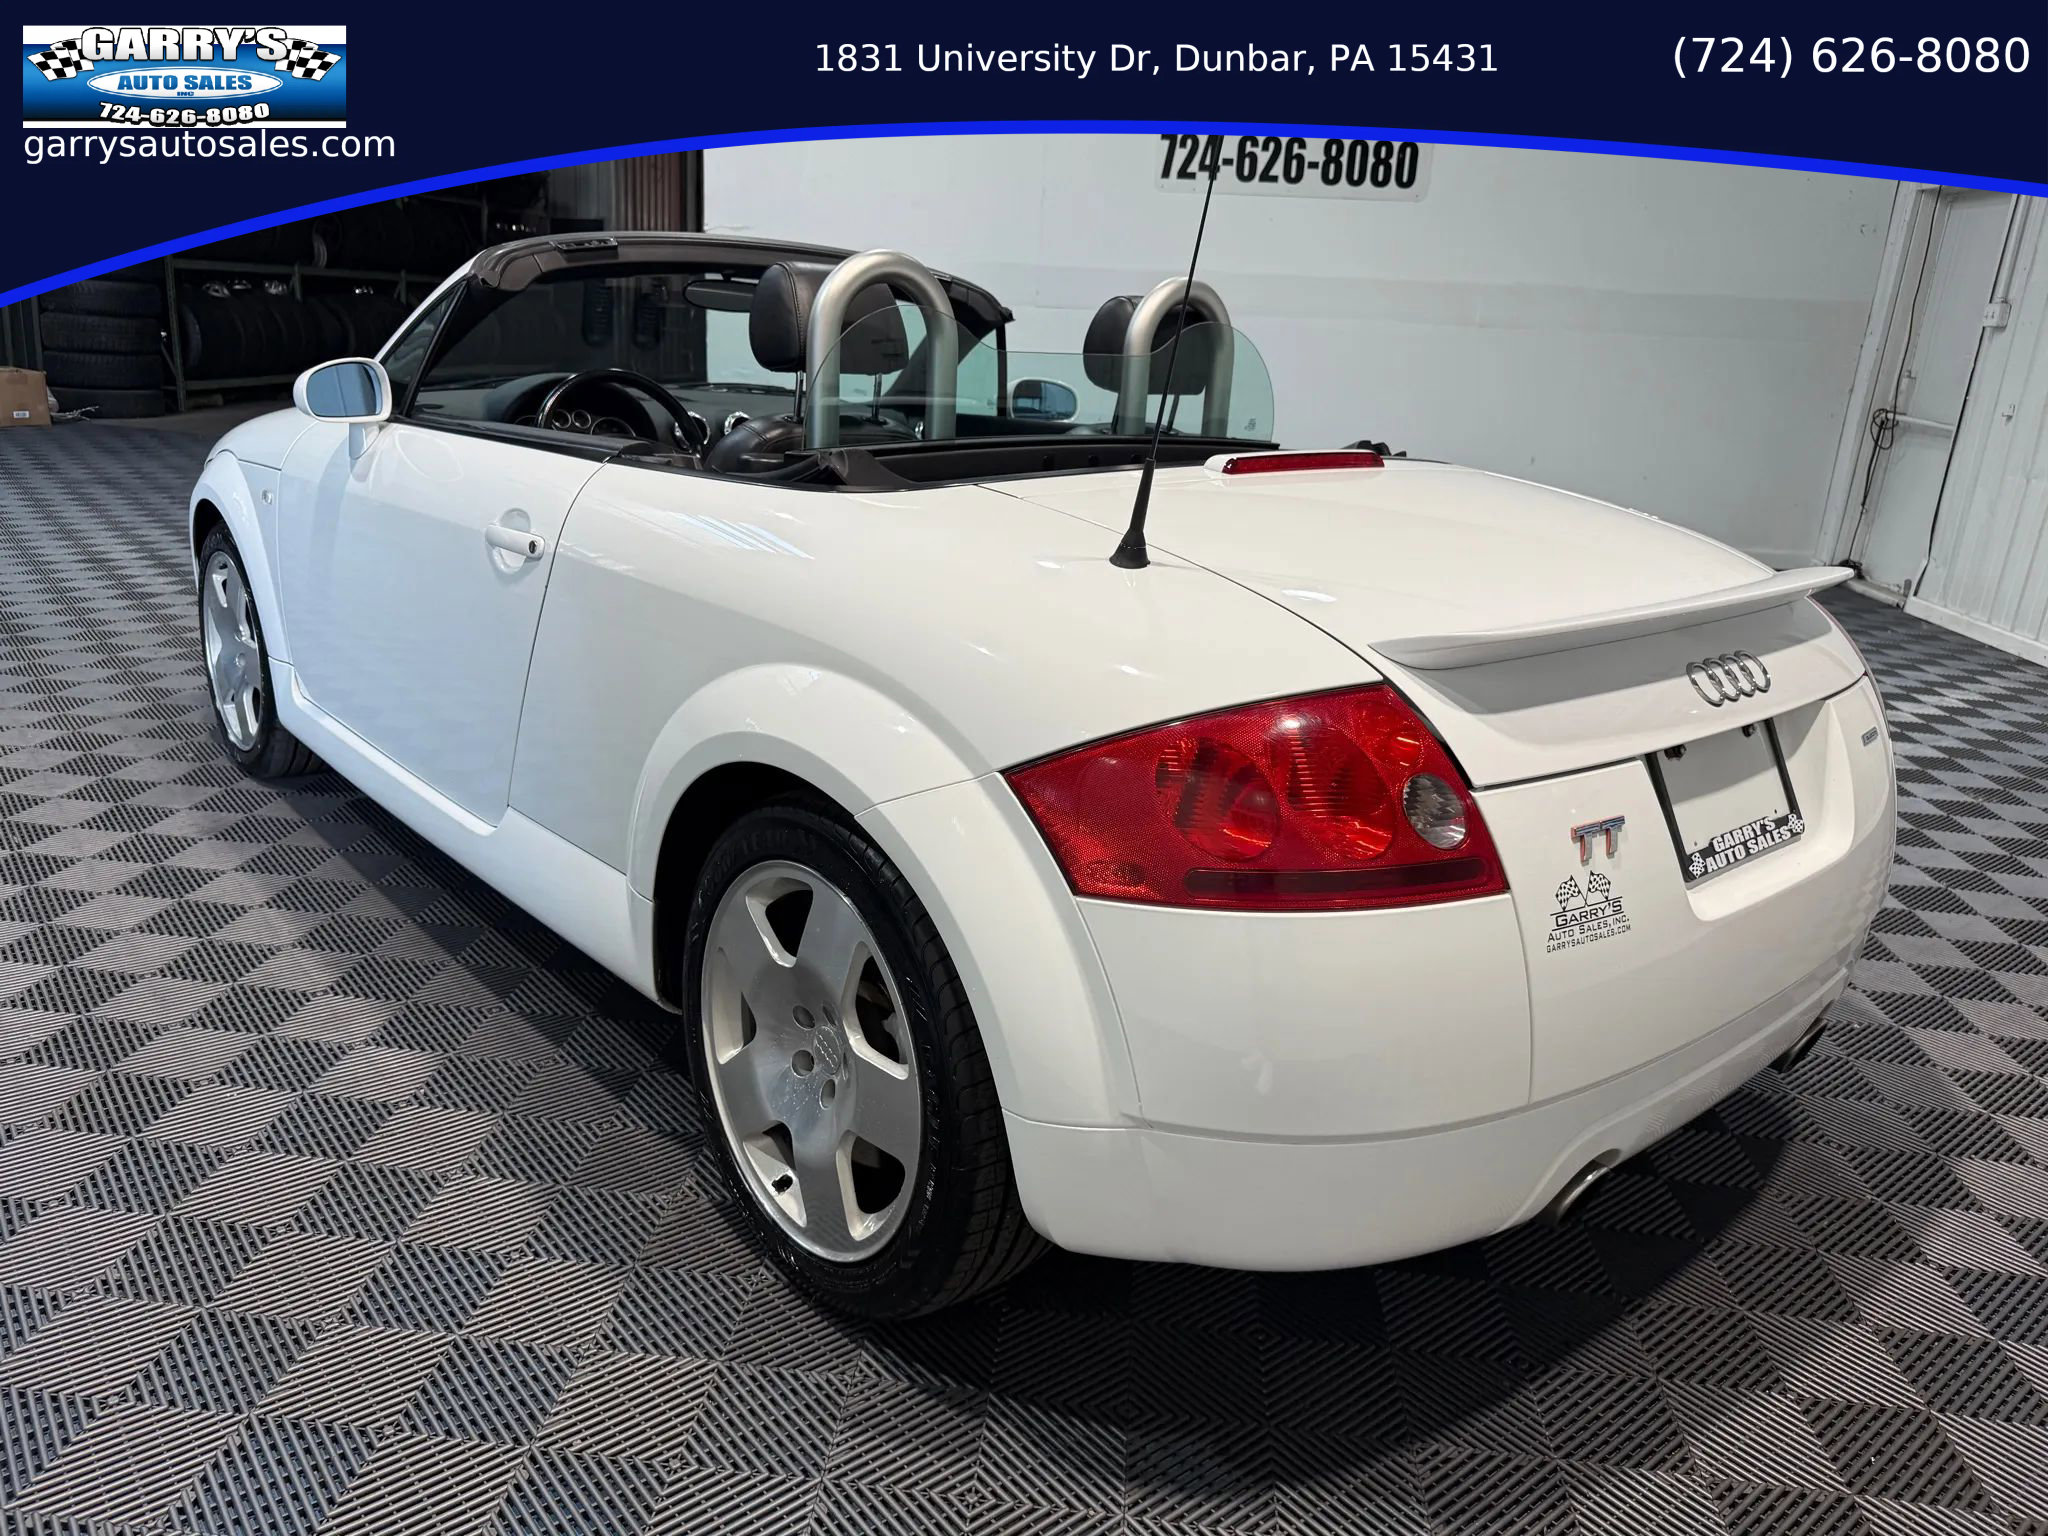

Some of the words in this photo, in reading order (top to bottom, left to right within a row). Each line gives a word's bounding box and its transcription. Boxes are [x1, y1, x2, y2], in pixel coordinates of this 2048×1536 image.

[1160, 134, 1419, 189] 724-626-8080
[1570, 815, 1626, 866] TT
[1705, 844, 1746, 873] AUTO
[1746, 825, 1791, 854] SALES
[1712, 817, 1776, 852] GARRY'S
[1555, 900, 1622, 927] GARRY'S
[1546, 924, 1632, 953] GARRYSAUTOSALES.COM
[1547, 929, 1574, 943] AUTO
